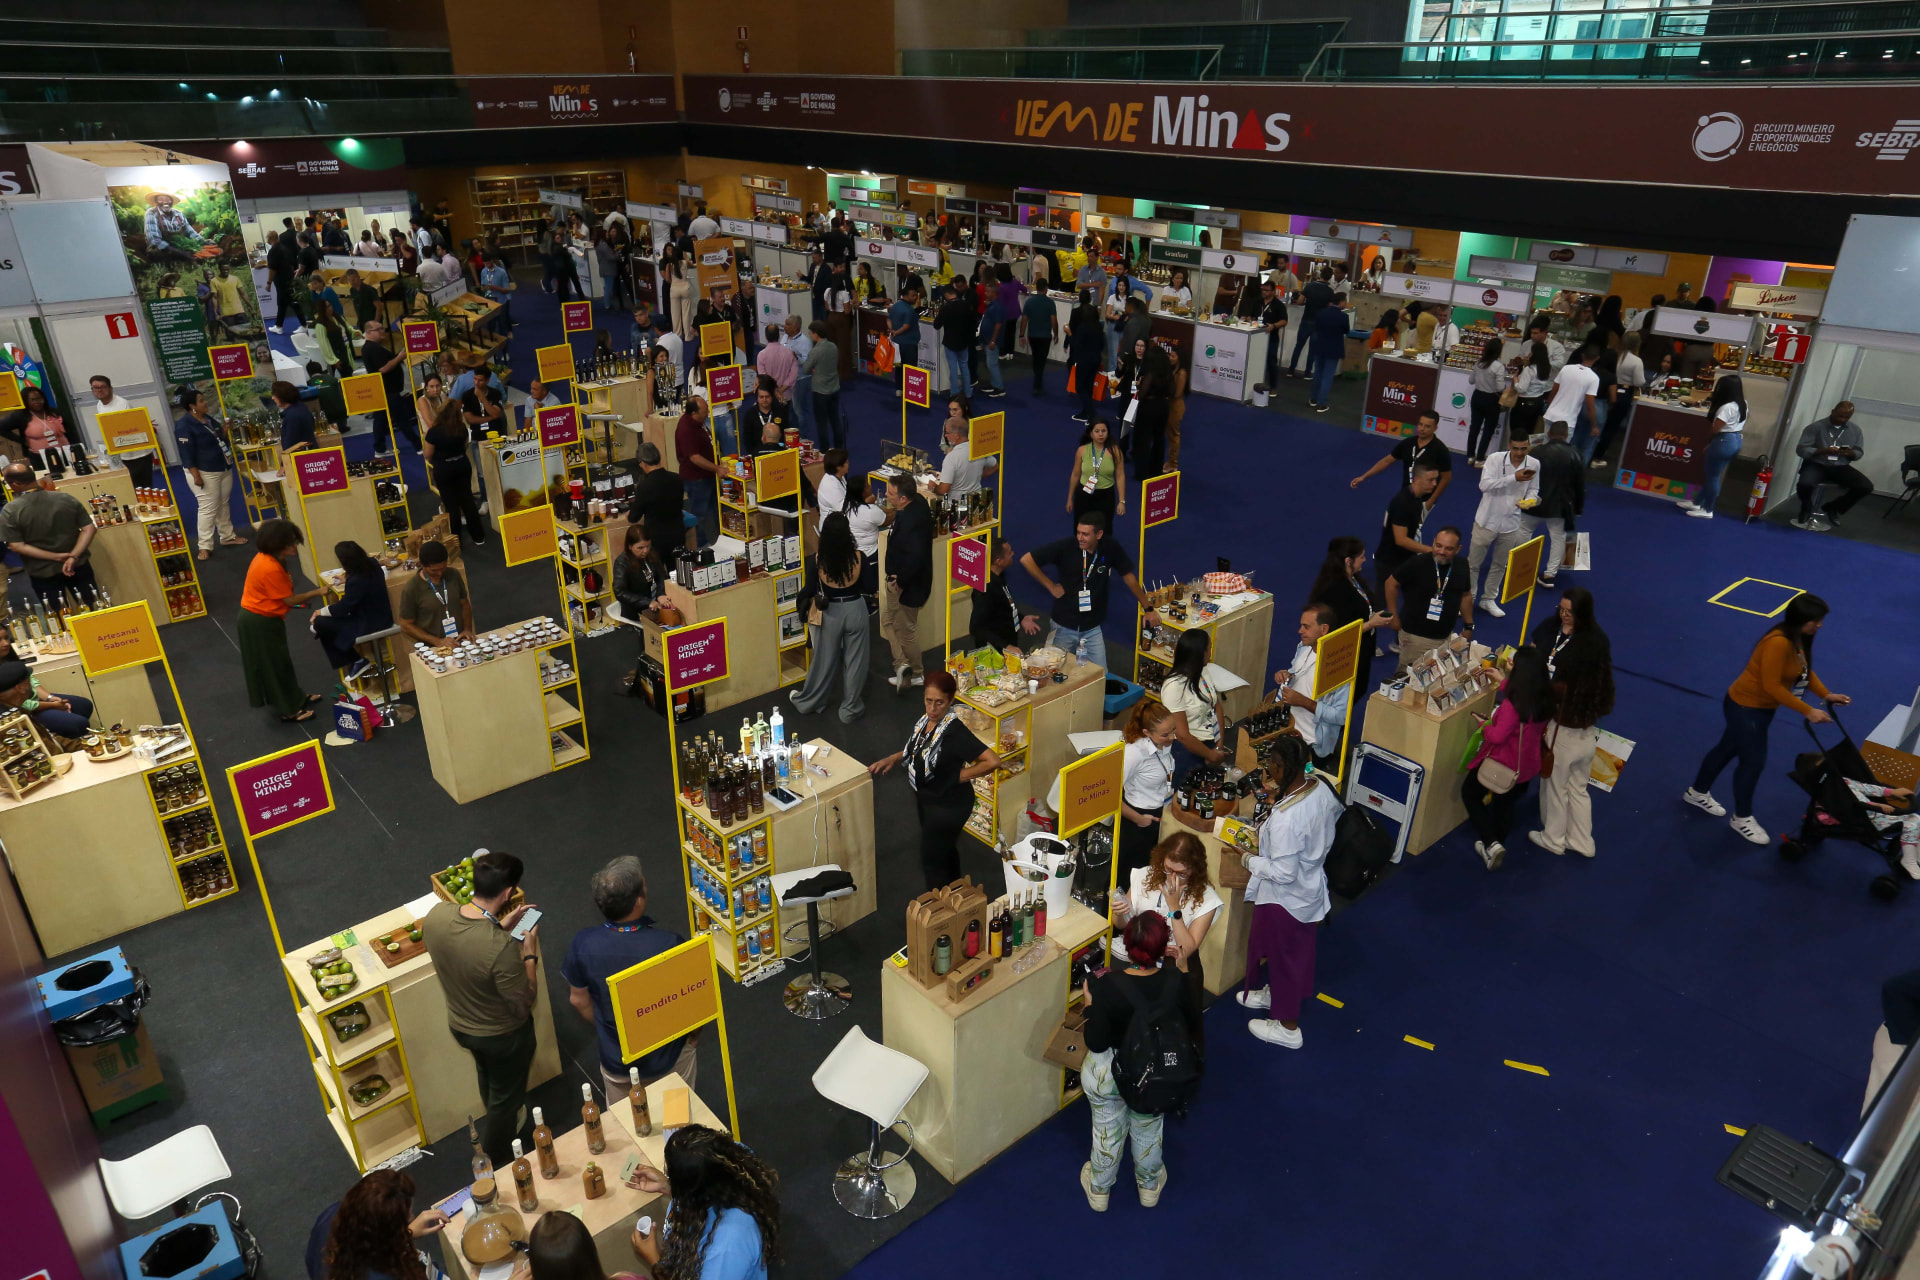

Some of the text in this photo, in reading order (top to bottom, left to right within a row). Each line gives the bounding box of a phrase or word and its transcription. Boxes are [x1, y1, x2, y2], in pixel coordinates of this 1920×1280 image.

[810, 92, 836, 101] GOVERNO
[810, 101, 836, 110] DE MINAS
[1015, 99, 1143, 142] VEM DE
[1151, 95, 1292, 152] Minas
[1753, 123, 1835, 135] CIRCUITO MINEIRO
[1751, 133, 1832, 143] DE OPORTUNIDADES
[1748, 142, 1800, 153] E NEGÓCIOS
[238, 166, 266, 174] SEBRAE
[1756, 289, 1797, 306] Linken
[1220, 366, 1243, 375] GOVERNO
[1227, 373, 1242, 381] MINAS
[546, 415, 567, 424] ORIGEM
[546, 420, 564, 428] MINAS
[304, 458, 331, 469] ORIGEM
[305, 465, 328, 474] MINAS
[1151, 487, 1169, 498] ORIGEM
[1151, 493, 1166, 503] MINAS
[958, 545, 977, 559] ORIGEM
[958, 552, 975, 563] MINAS
[98, 627, 141, 643] Artesanal
[104, 637, 141, 650] Sabores
[677, 638, 709, 654] ORIGEM
[678, 647, 705, 660] MINAS
[252, 768, 298, 791] ORIGEM
[255, 779, 292, 798] MINAS
[1081, 778, 1106, 793] Poesia
[1078, 788, 1110, 805] De Minas
[636, 978, 707, 1018] Bendito Licor
